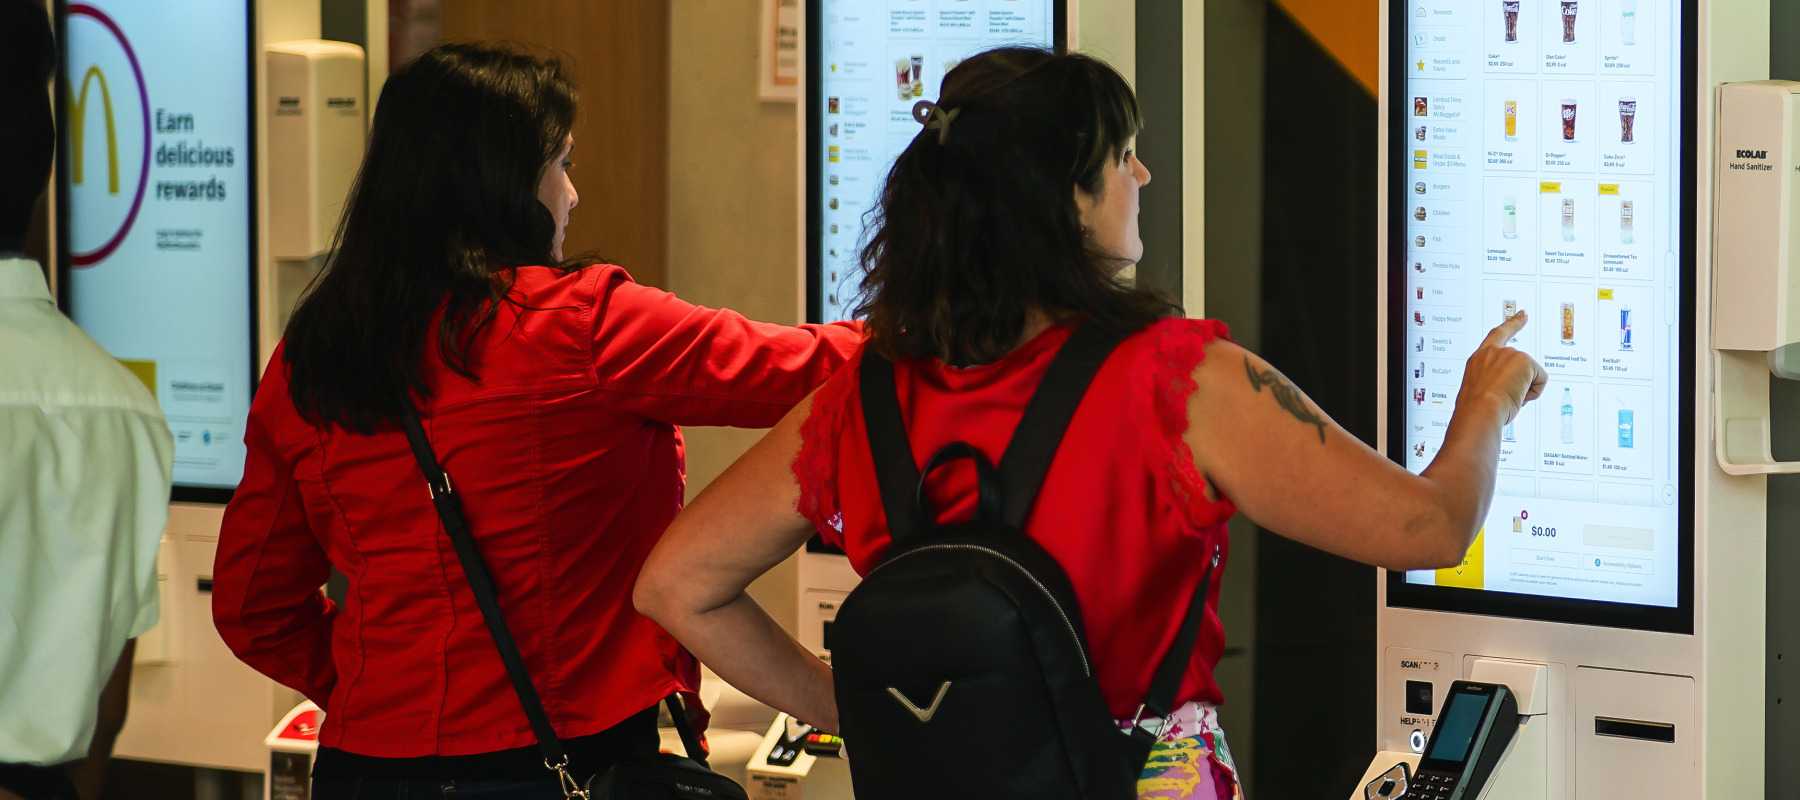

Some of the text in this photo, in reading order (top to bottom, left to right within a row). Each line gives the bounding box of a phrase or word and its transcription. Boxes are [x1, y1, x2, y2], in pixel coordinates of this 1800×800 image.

[156, 109, 193, 133] Earn
[156, 142, 234, 167] delicious
[1736, 150, 1767, 159] ECOLAB
[1730, 162, 1773, 171] Hand Sanitizer
[156, 176, 226, 201] rewards
[1531, 525, 1556, 538] $0.00
[1400, 717, 1416, 725] HELP
